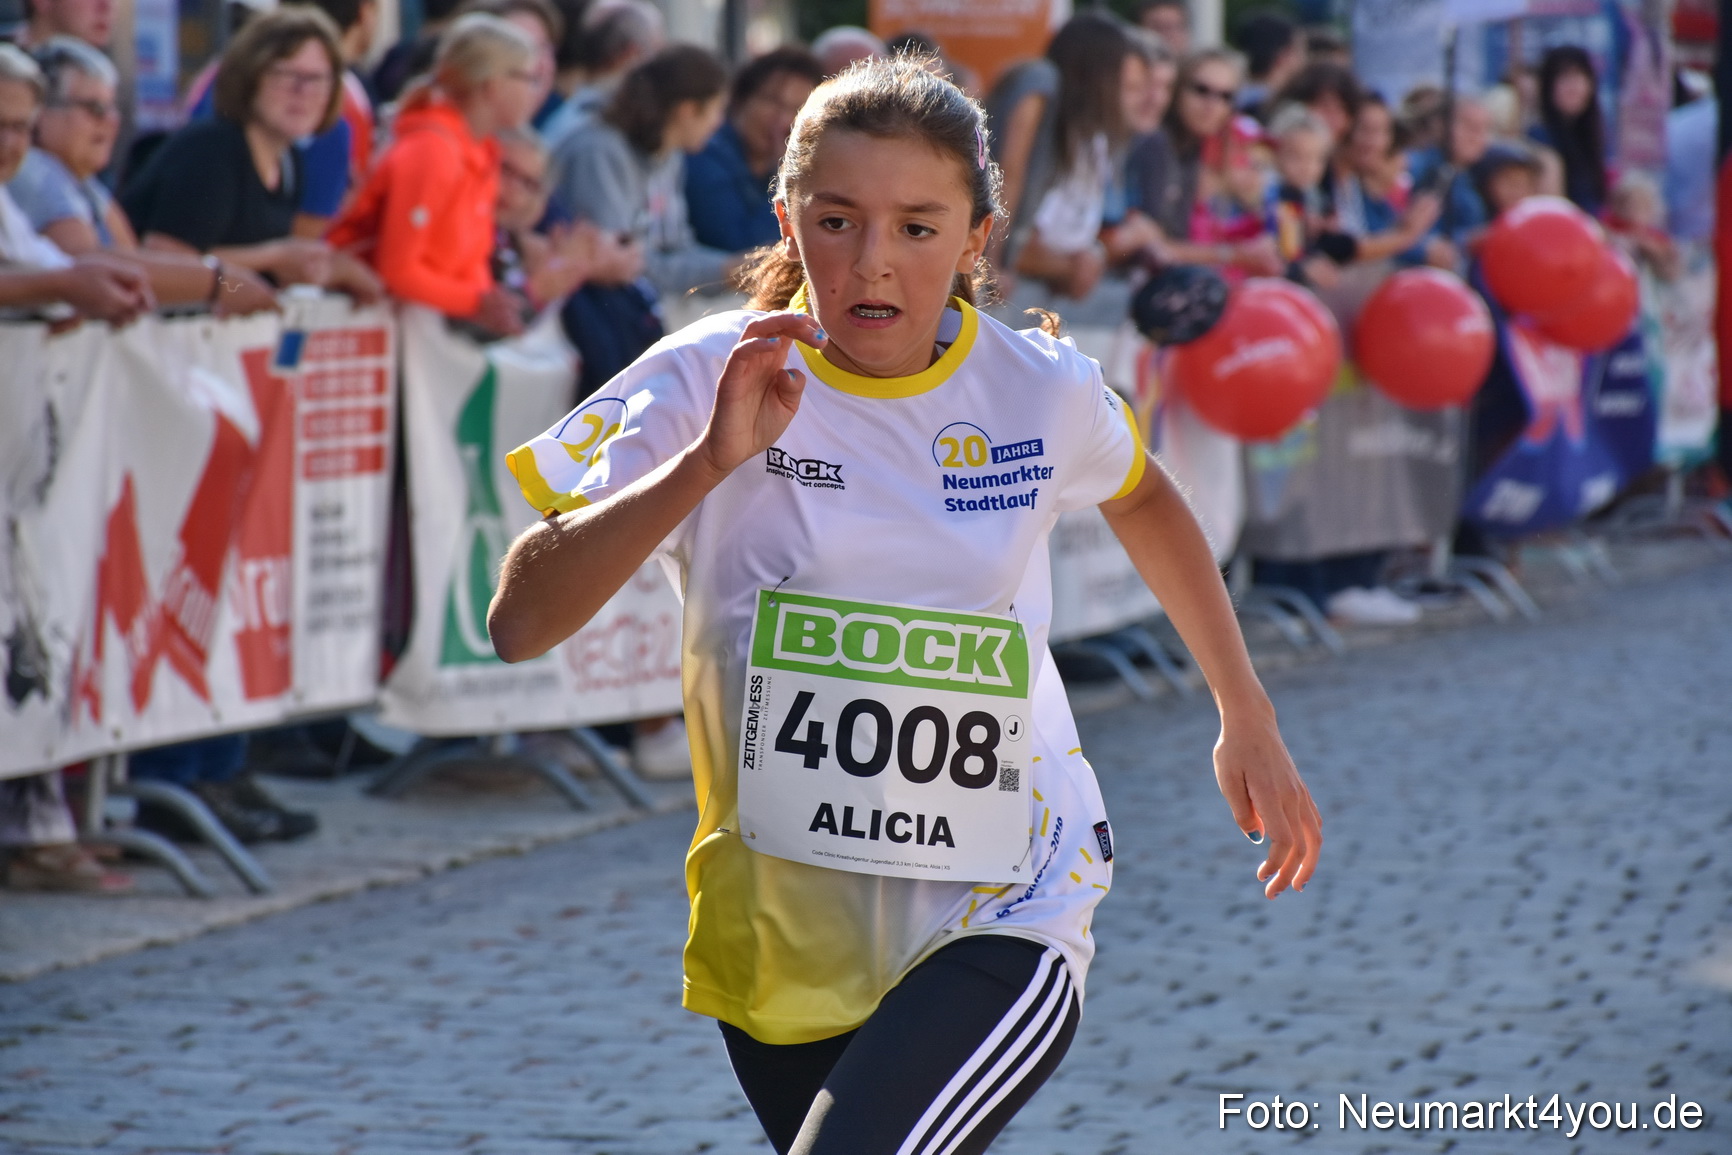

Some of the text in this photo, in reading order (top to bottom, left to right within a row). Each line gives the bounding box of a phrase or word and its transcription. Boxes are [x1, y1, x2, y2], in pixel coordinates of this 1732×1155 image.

[767, 447, 844, 483] BOCK
[938, 434, 988, 468] 20
[995, 441, 1040, 463] JAHRE
[813, 481, 846, 491] concepts
[942, 465, 1054, 490] Neumarkter
[944, 488, 1039, 512] Stadtlauf
[773, 602, 1012, 687] BOCK
[758, 676, 773, 771] TRANSPONDER ZEITMESSUNG
[1009, 721, 1018, 736] J
[774, 690, 1001, 789] 4008
[808, 801, 956, 849] ALICIA
[811, 849, 824, 857] Code
[824, 851, 836, 859] Clinic
[870, 858, 896, 867] Jugendlauf
